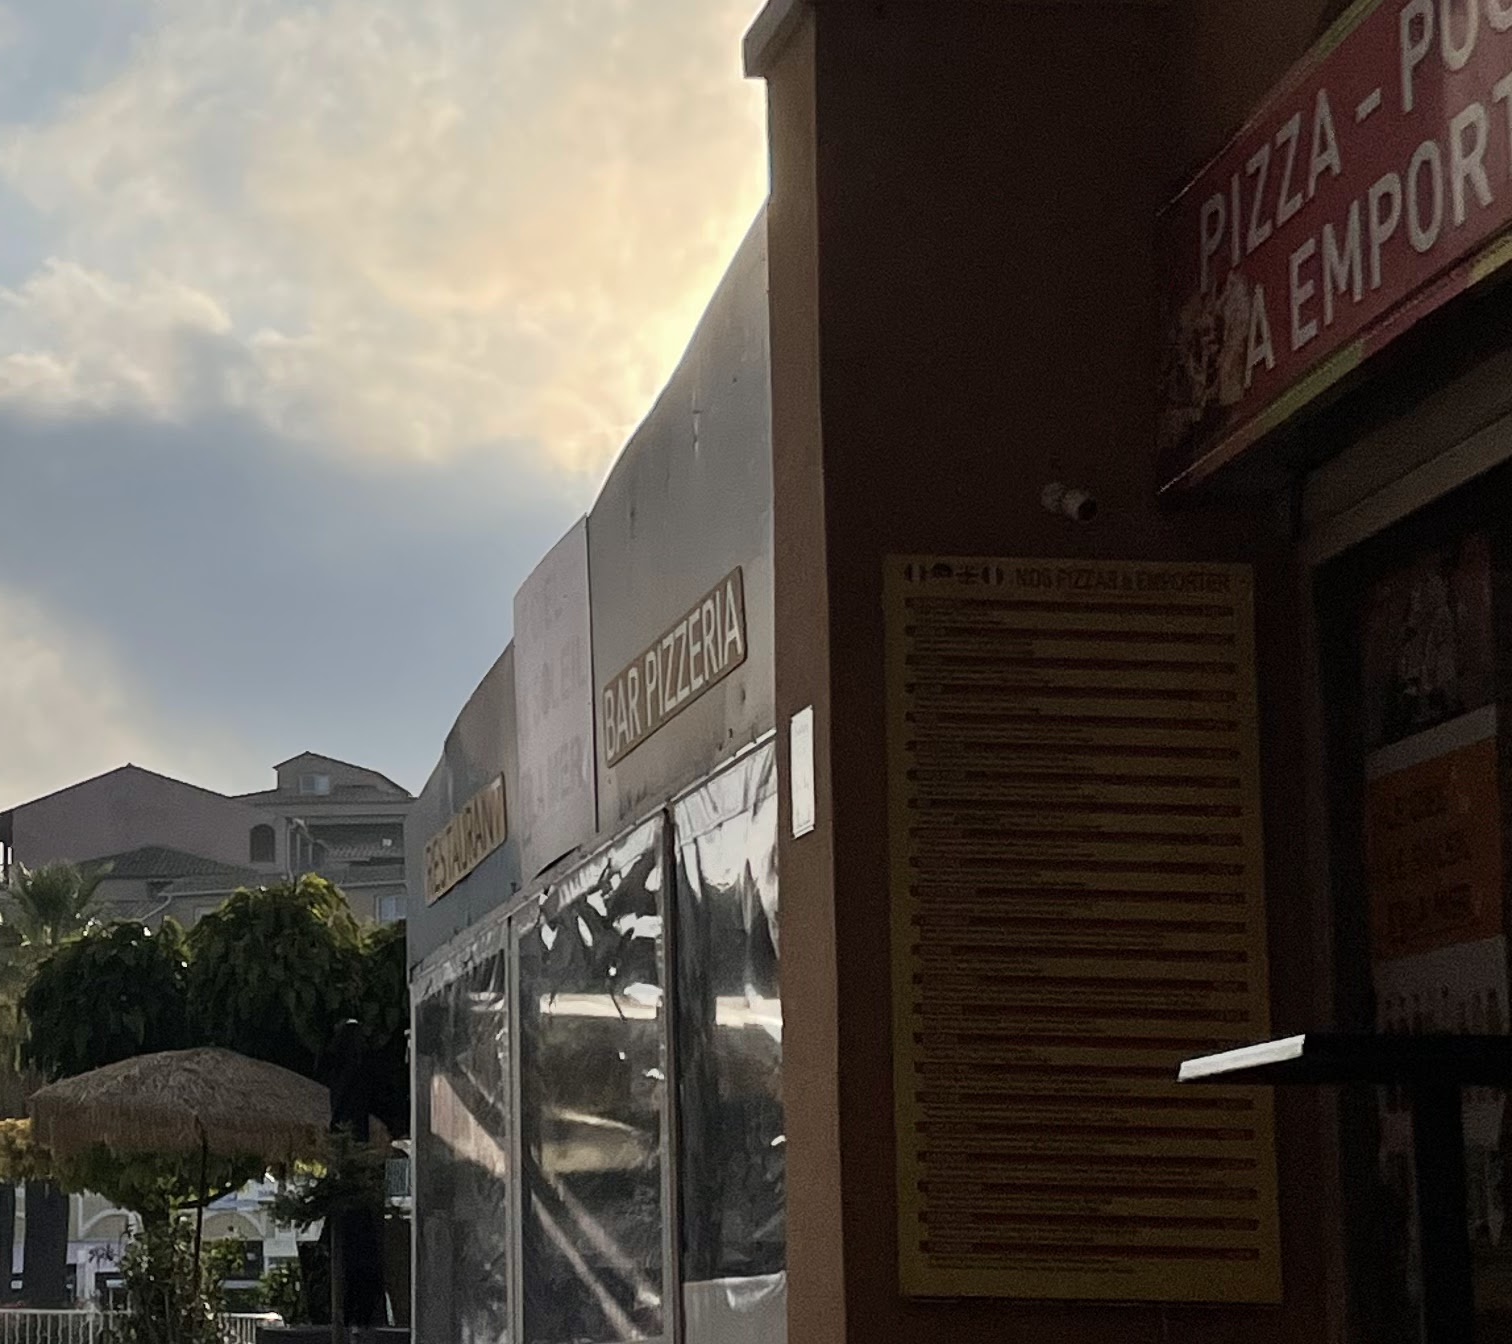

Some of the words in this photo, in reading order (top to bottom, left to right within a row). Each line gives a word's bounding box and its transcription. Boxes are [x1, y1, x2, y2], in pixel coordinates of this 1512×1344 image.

[1198, 87, 1342, 290] PIZZA
[604, 666, 642, 758] BAR
[644, 579, 744, 728] PIZZERIA
[426, 778, 505, 899] RESTAURANT
